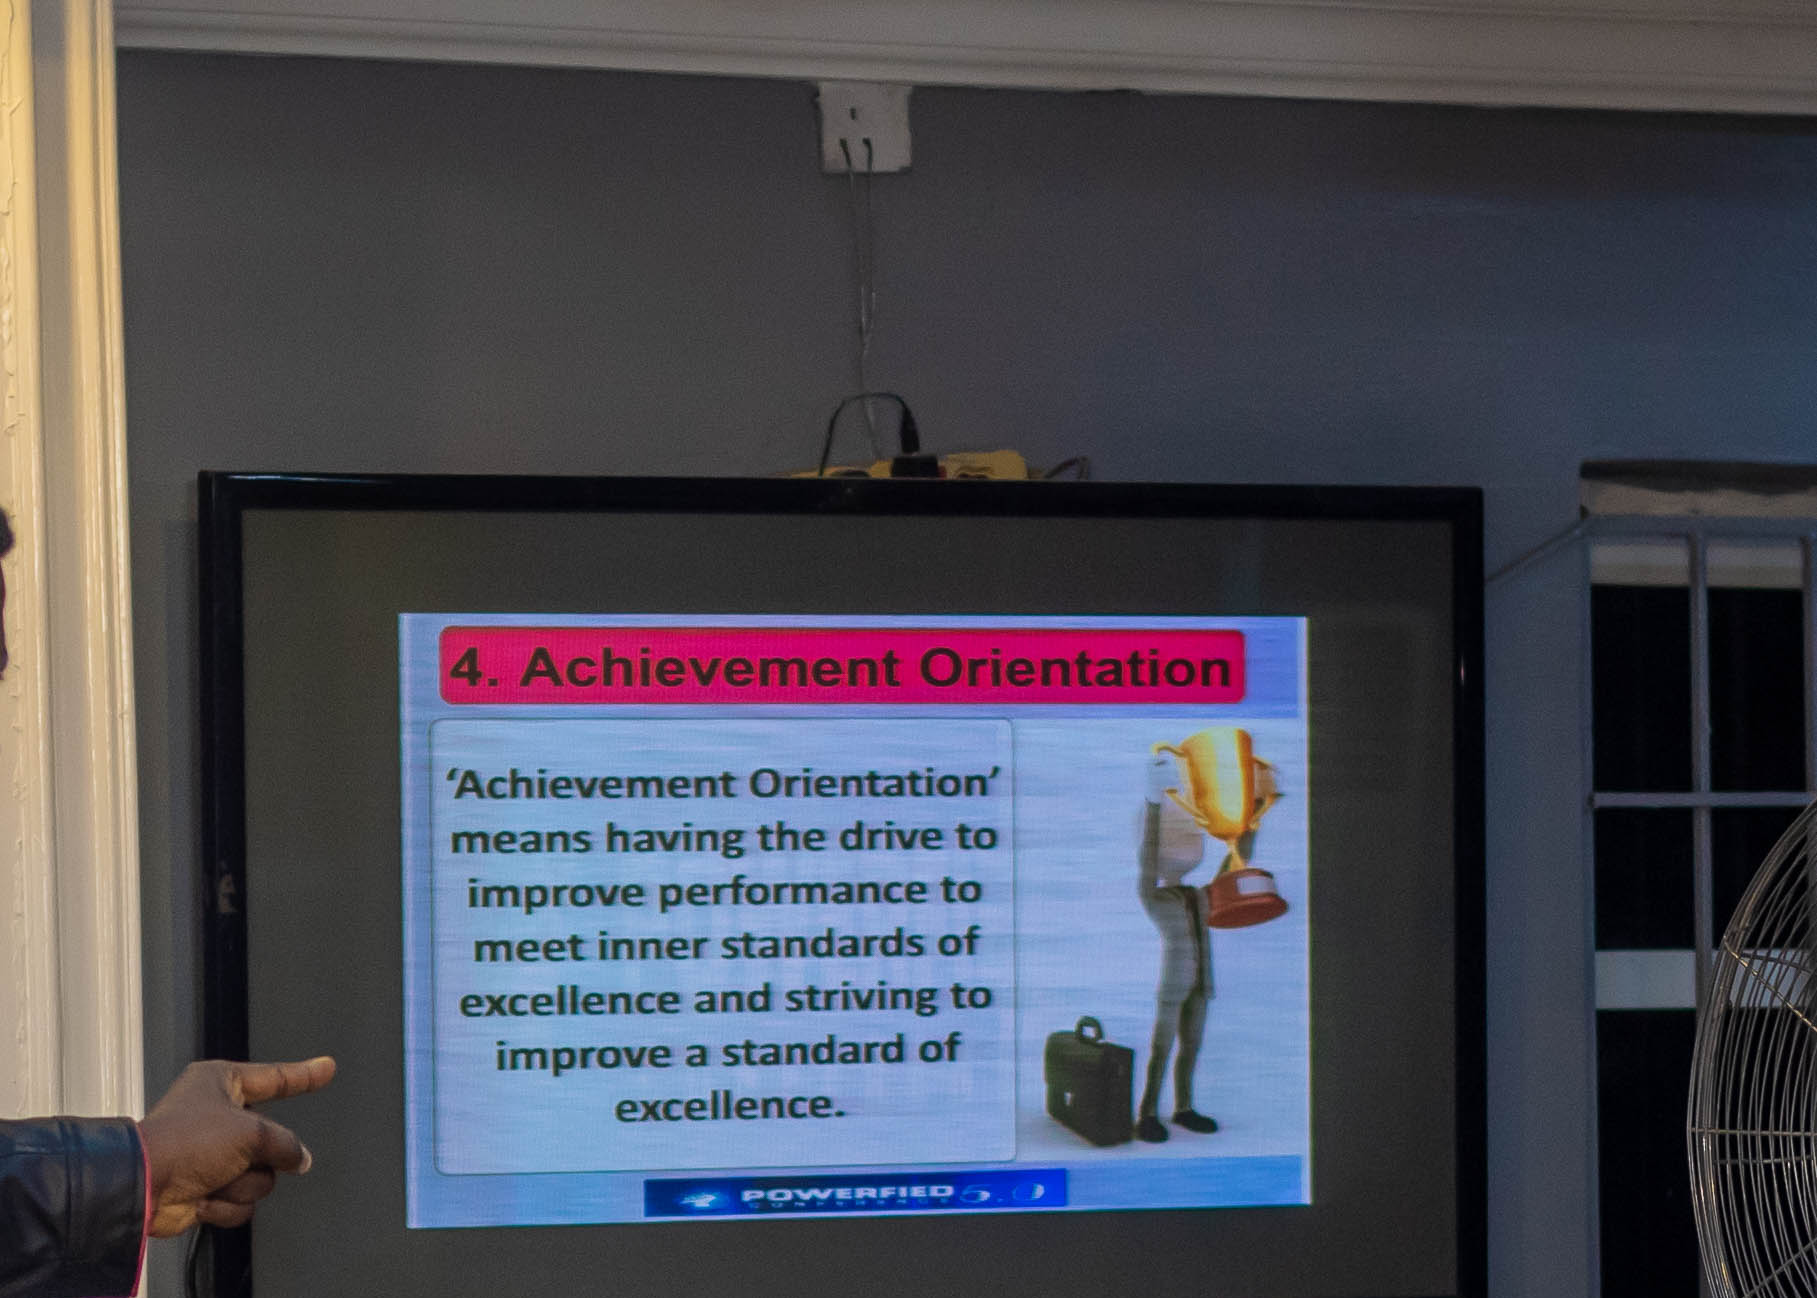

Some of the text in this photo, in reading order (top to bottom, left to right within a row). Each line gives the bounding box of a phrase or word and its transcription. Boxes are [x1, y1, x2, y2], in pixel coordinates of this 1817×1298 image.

[449, 647, 1230, 688] 4. Achievement Orientation
[452, 820, 999, 860] means having the drive to
[468, 873, 983, 915] improve performance to
[474, 924, 982, 963] meet inner standards of
[460, 979, 995, 1018] excellence and striving to
[496, 1031, 963, 1078] improve a standard of
[616, 1089, 847, 1123] excellence.
[742, 1185, 954, 1202] POWERFIED
